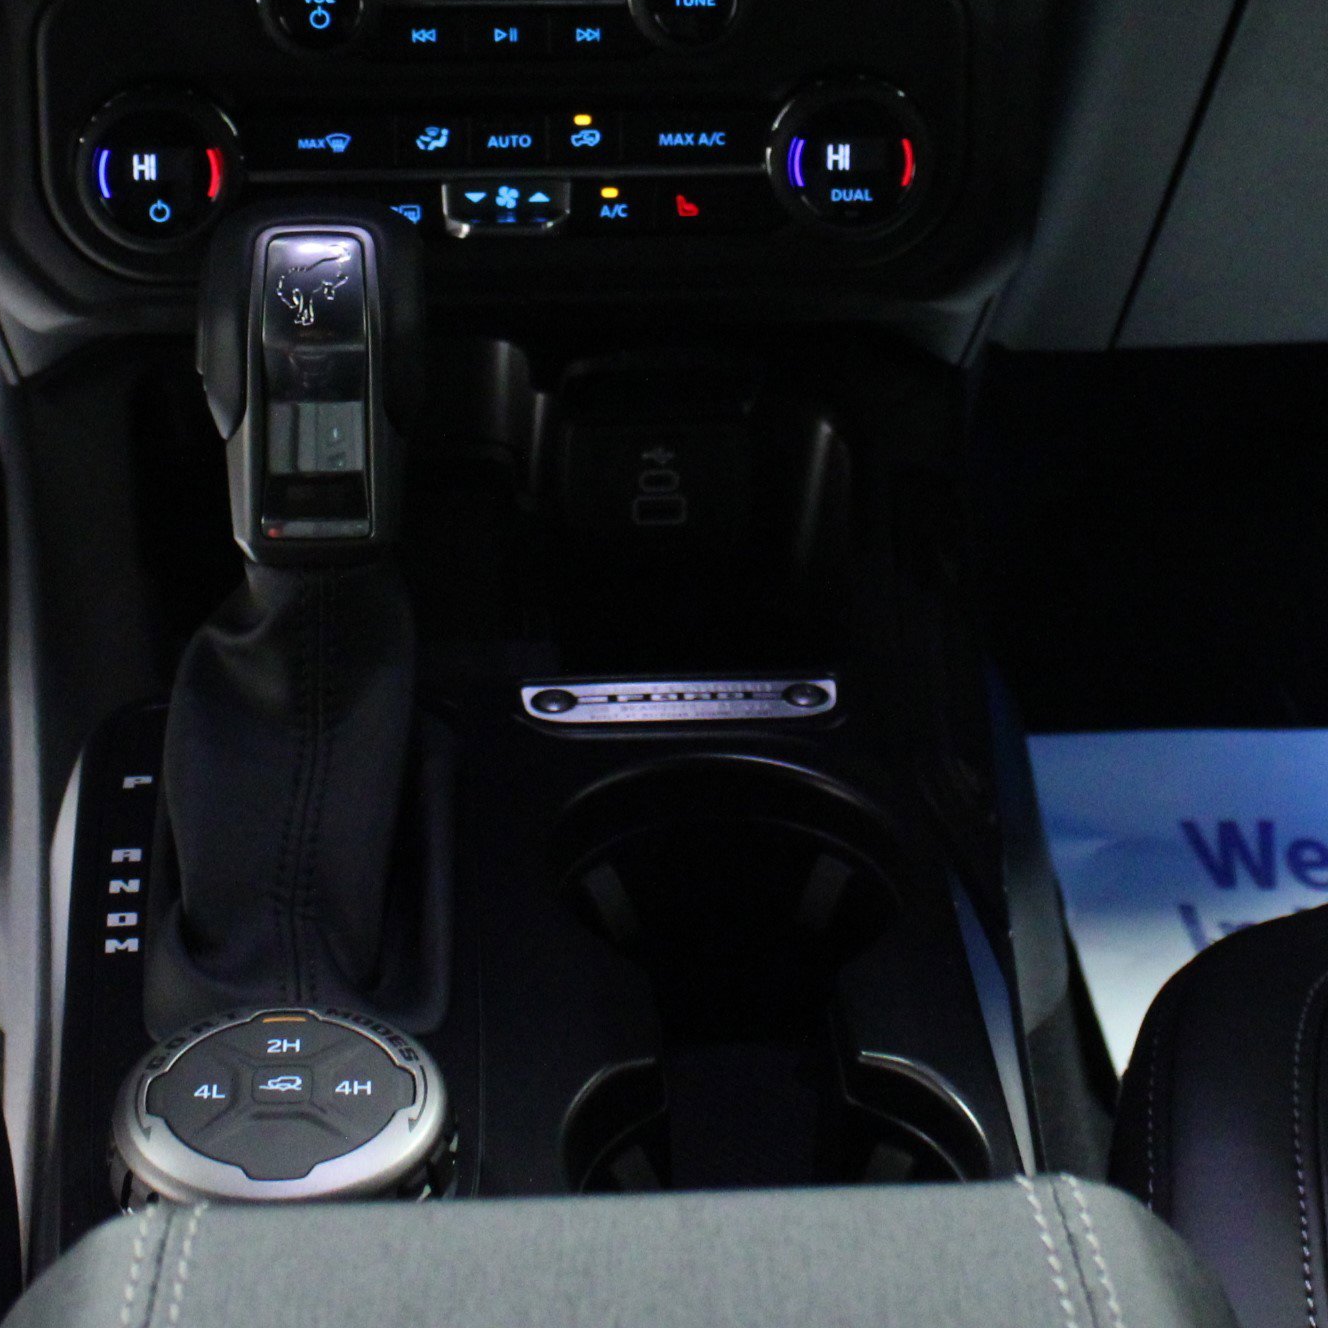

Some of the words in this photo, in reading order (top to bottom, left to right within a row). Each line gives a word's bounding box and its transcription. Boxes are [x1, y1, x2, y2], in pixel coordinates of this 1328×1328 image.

[297, 137, 325, 149] MAX
[487, 134, 532, 148] AUTO
[658, 132, 694, 146] MAX
[698, 131, 726, 147] A/C
[826, 144, 851, 170] HI
[132, 154, 158, 181] HI
[830, 188, 873, 202] DUAL
[600, 203, 629, 219] A/C
[122, 776, 153, 789] P
[108, 879, 140, 894] N
[104, 938, 139, 954] M
[266, 1038, 301, 1054] 2H
[193, 1084, 226, 1099] 4L
[334, 1080, 373, 1096] 4H
